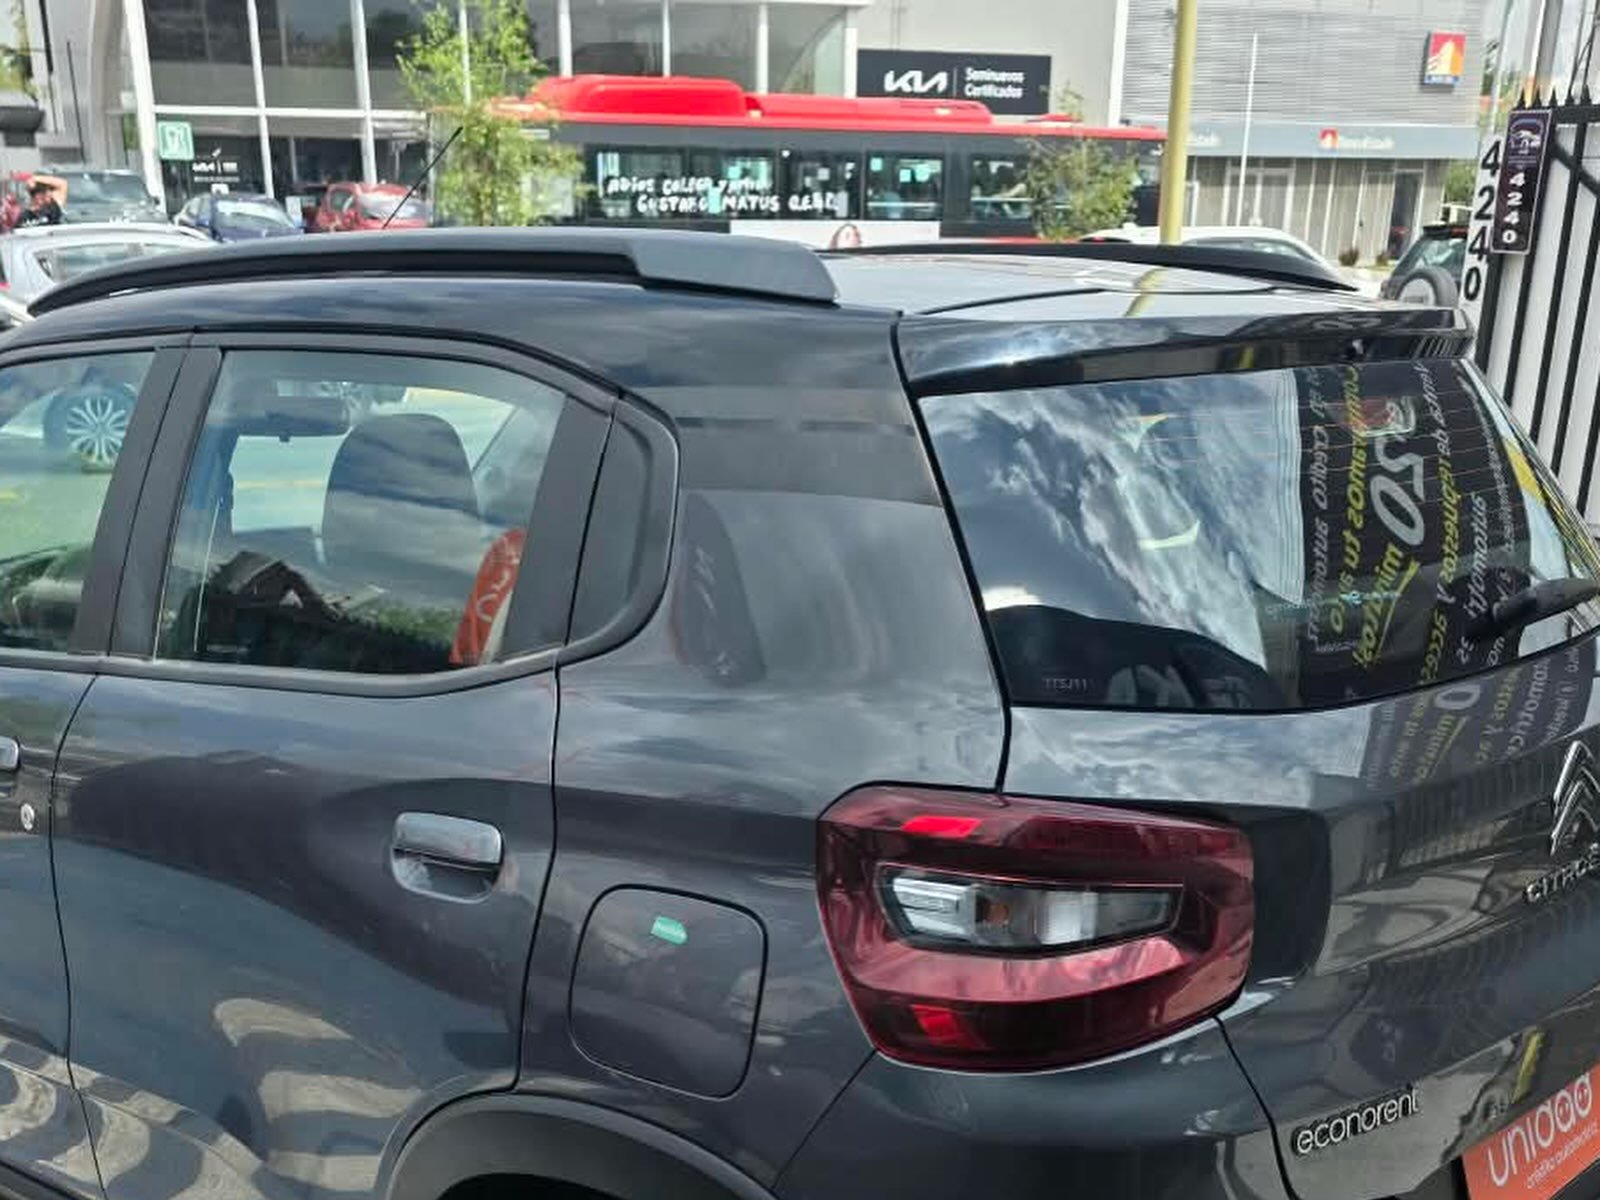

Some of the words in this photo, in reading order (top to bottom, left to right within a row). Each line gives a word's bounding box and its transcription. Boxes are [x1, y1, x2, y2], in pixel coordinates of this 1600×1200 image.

[884, 70, 948, 93] KIA
[964, 67, 1025, 83] Seminuevos
[963, 84, 1023, 99] Certificados
[722, 194, 780, 213] MATUS
[1502, 172, 1526, 244] 4240
[1464, 140, 1502, 302] 4240
[1296, 1086, 1419, 1154] econorent
